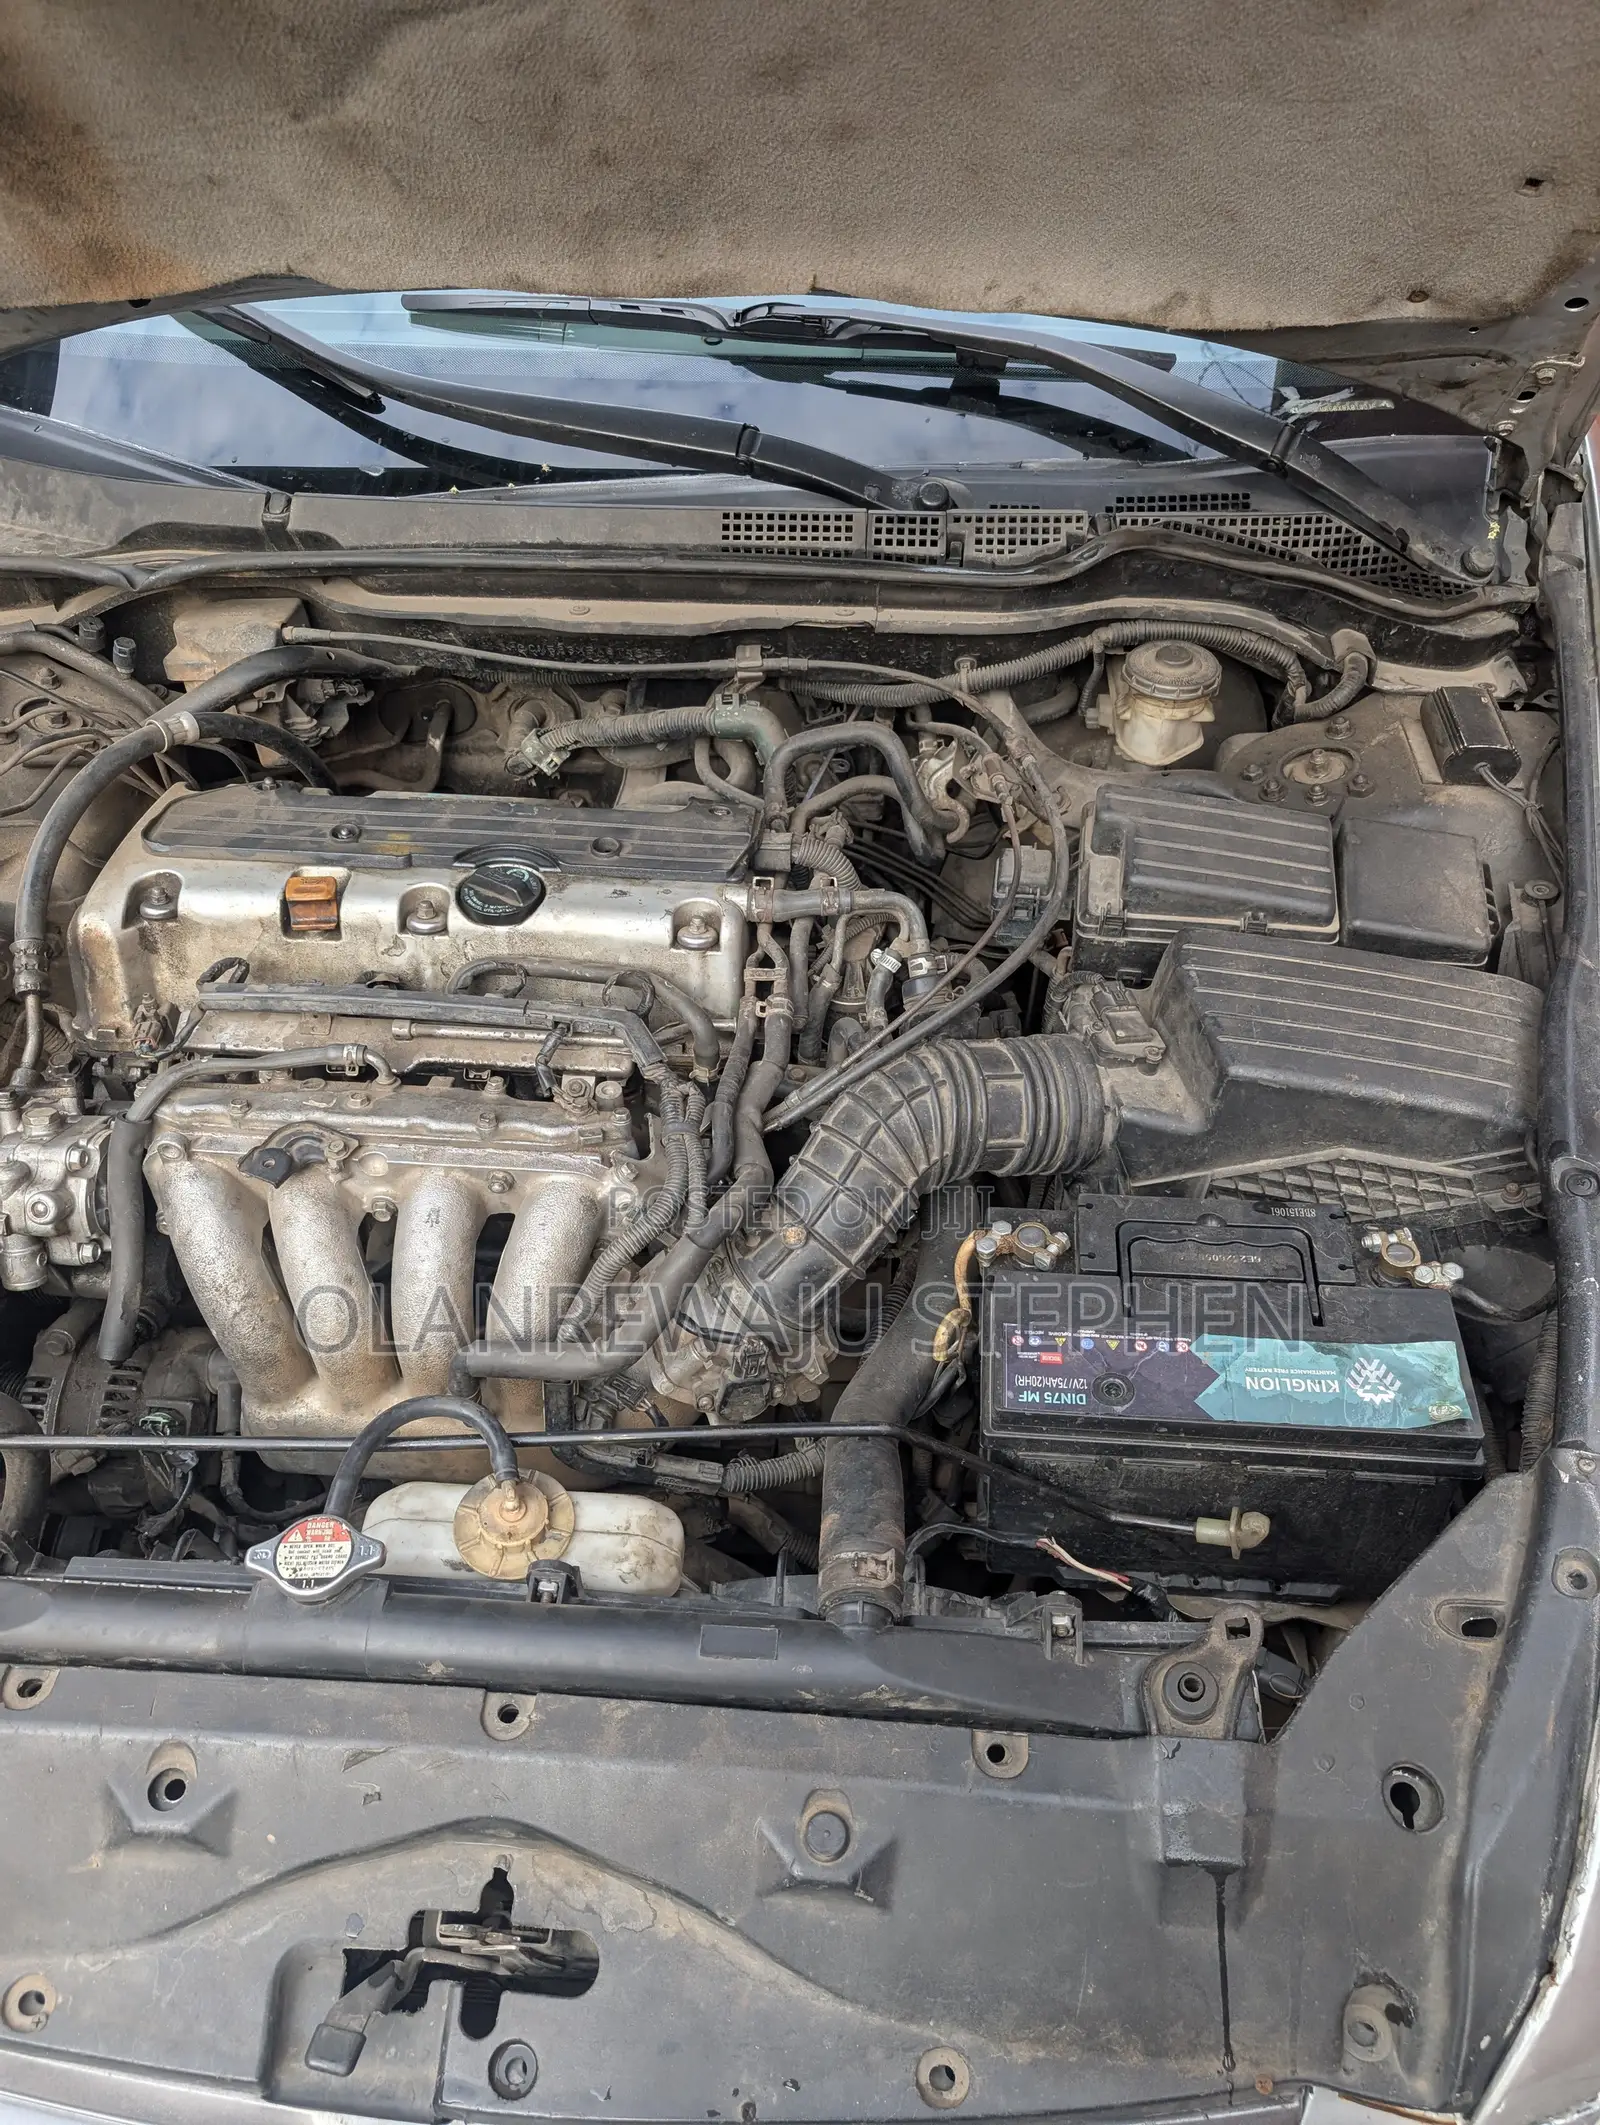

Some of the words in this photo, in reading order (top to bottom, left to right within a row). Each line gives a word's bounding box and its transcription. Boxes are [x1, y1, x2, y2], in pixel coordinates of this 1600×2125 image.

[1270, 1206, 1317, 1218] 8BE151061
[1014, 1375, 1088, 1389] 12V/75Ah(20HR)
[1245, 1376, 1341, 1393] KINGLION
[1018, 1391, 1040, 1402] MF
[1044, 1391, 1087, 1405] DIN75
[306, 1521, 334, 1529] DANGER
[301, 1579, 315, 1589] 1.1
